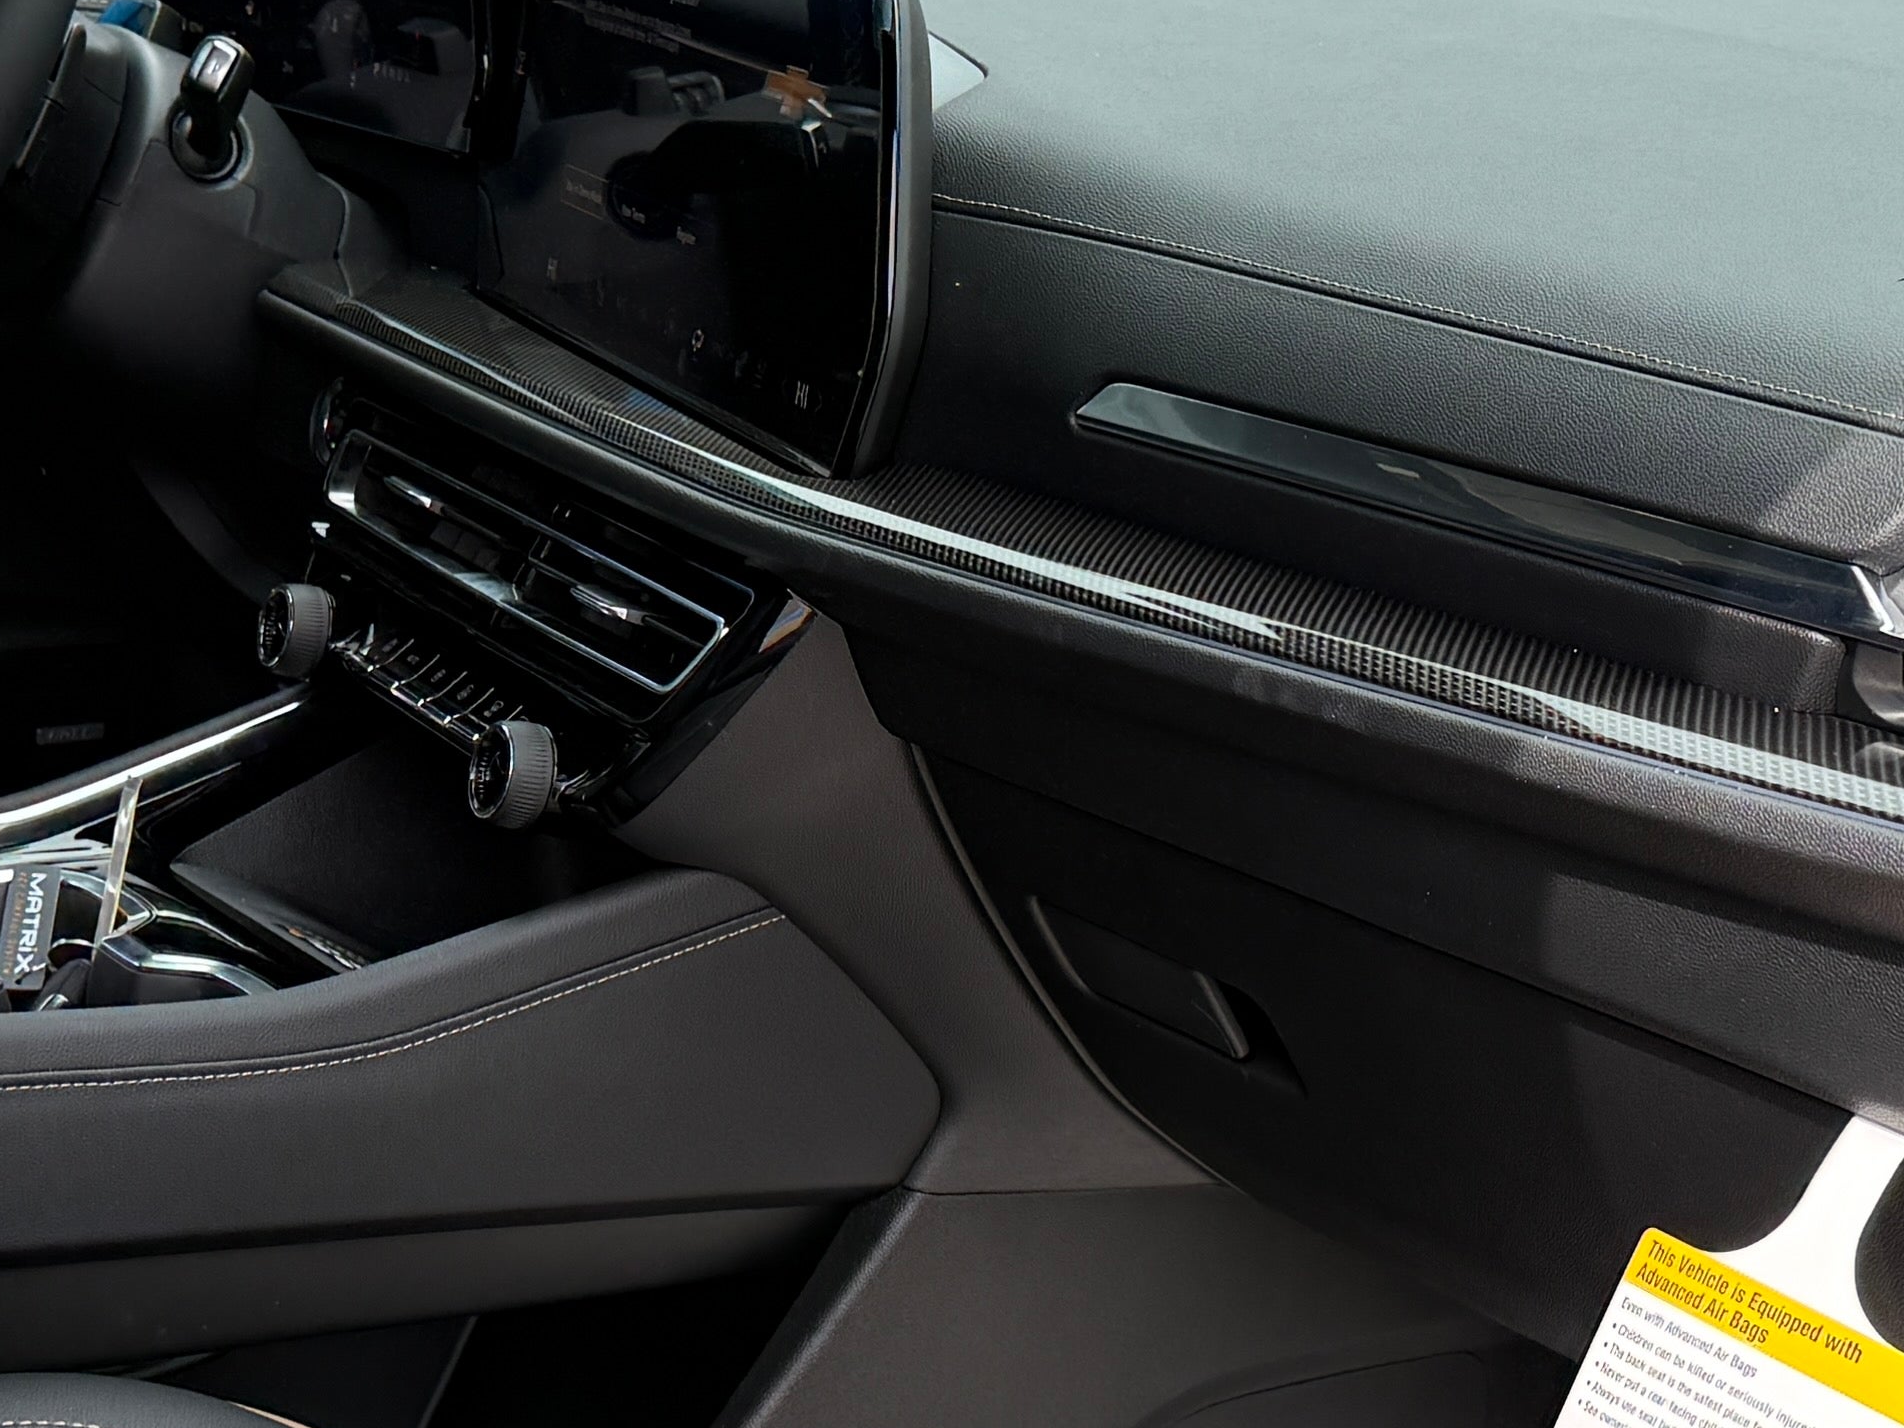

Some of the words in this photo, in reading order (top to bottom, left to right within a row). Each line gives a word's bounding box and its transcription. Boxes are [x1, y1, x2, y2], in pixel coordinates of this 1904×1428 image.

[14, 872, 48, 974] MATRIX
[1635, 1262, 1705, 1310] Advanced
[1702, 1298, 1729, 1323] Air
[1728, 1310, 1769, 1346] Bags
[1648, 1240, 1676, 1268] This
[1678, 1254, 1729, 1295] Vehicle
[1730, 1282, 1746, 1304] is
[1747, 1291, 1824, 1343] Equipped
[1824, 1333, 1863, 1364] with
[1644, 1311, 1665, 1329] with
[1664, 1321, 1714, 1355] Advanced
[1729, 1354, 1758, 1378] Bags
[1654, 1346, 1672, 1362] can
[1672, 1354, 1686, 1369] be
[1714, 1379, 1727, 1390] or
[1727, 1386, 1775, 1419] seriously
[1667, 1376, 1676, 1388] is
[1693, 1392, 1723, 1414] safest
[1722, 1408, 1751, 1428] place
